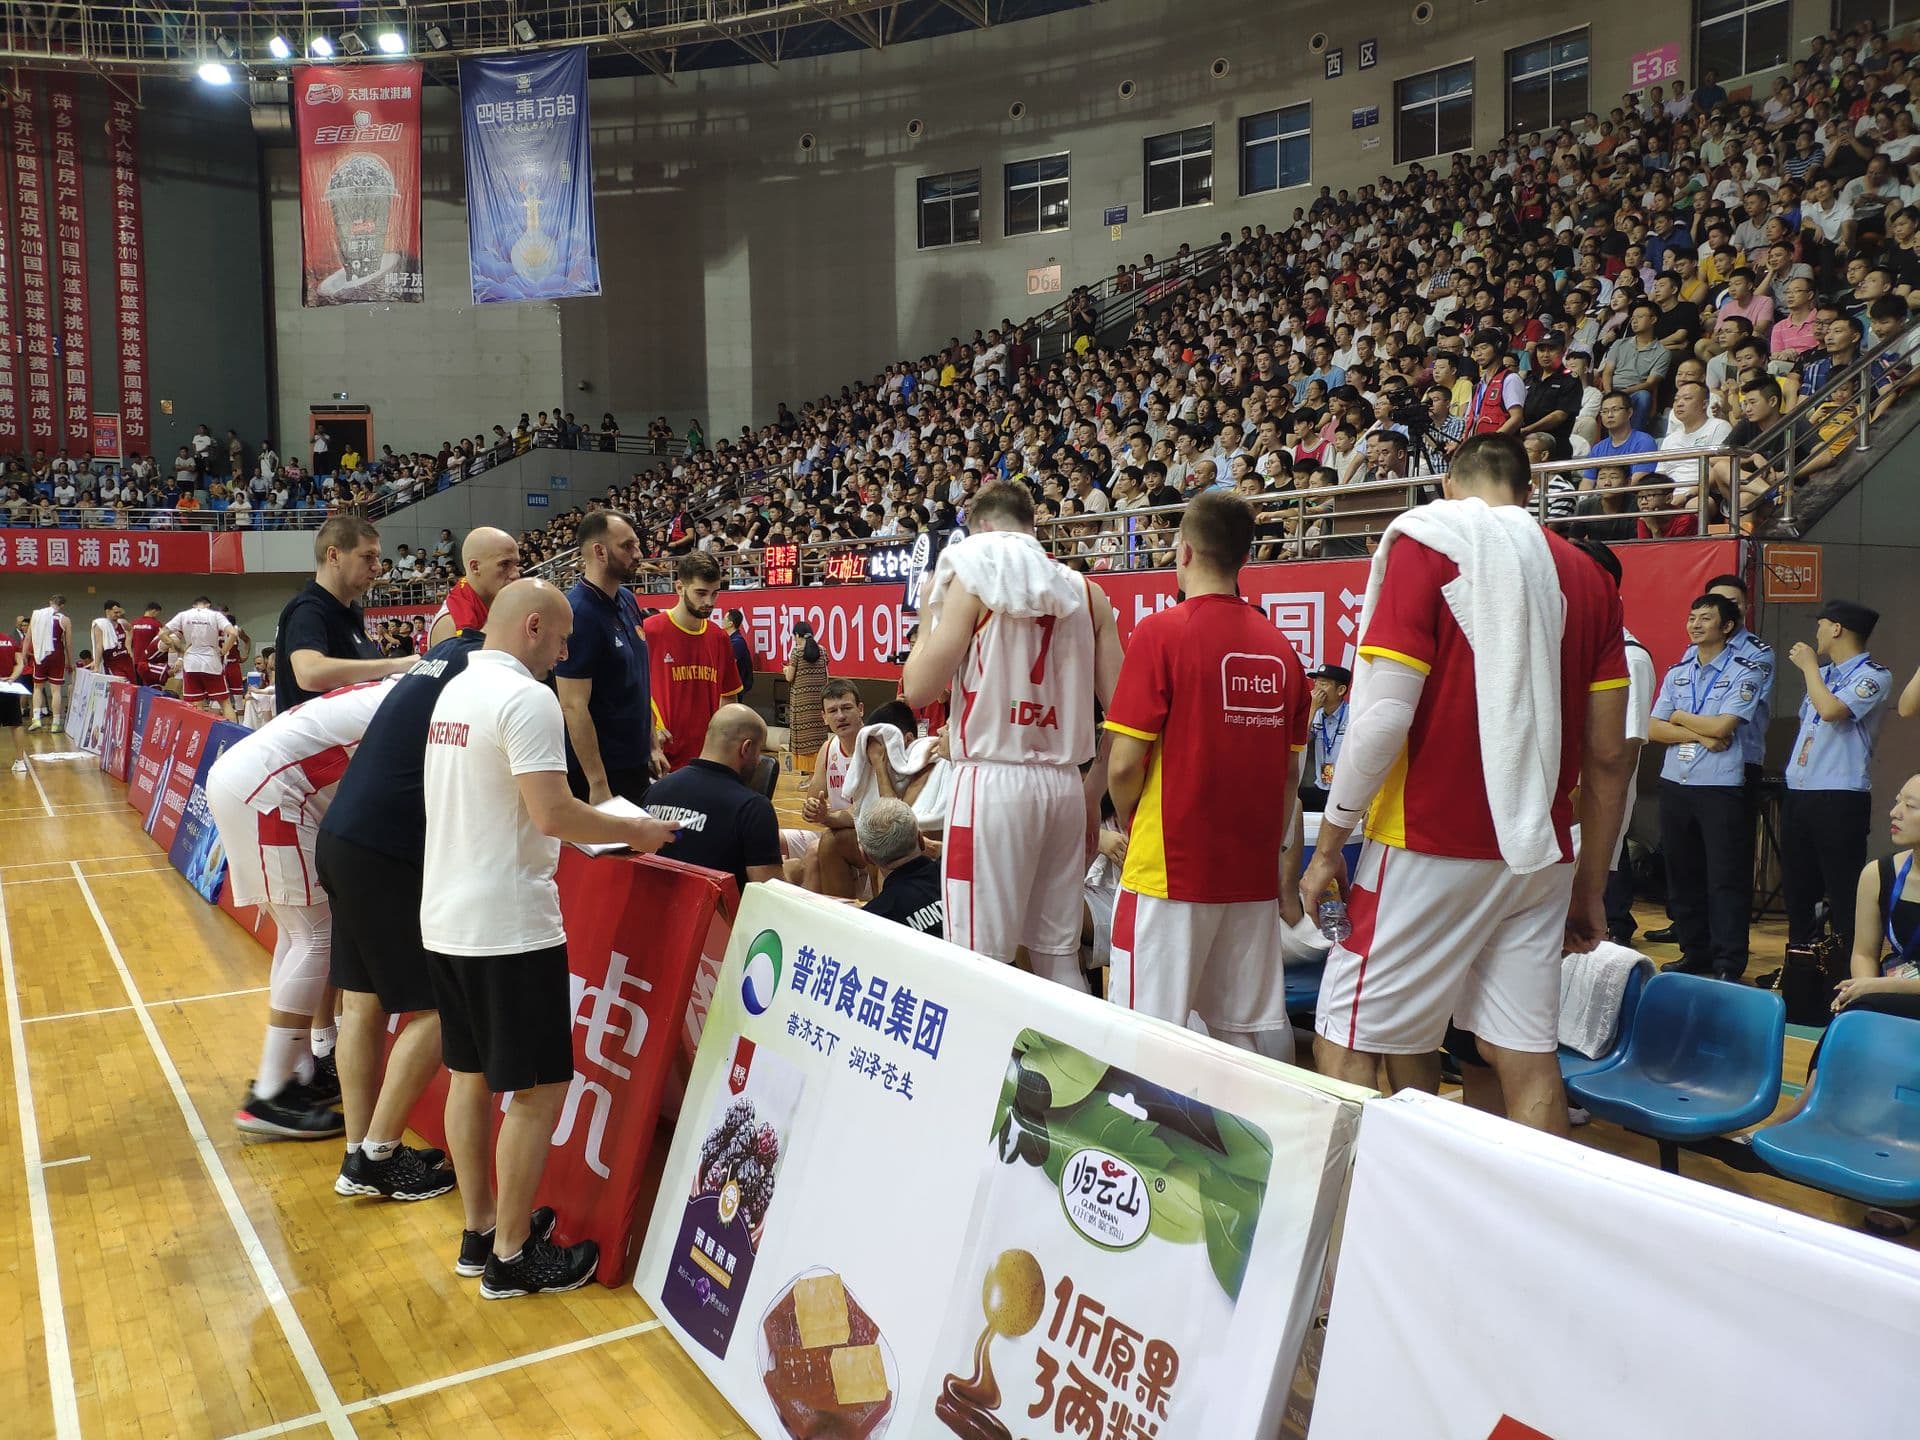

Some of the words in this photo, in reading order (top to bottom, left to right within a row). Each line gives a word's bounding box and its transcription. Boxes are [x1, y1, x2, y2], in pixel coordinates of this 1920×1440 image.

[1632, 56, 1678, 85] E3区
[1231, 672, 1279, 694] m:tel
[791, 945, 949, 1061] 普润食品集团
[786, 1011, 841, 1057] 普济天下
[848, 1046, 914, 1101] 润泽苍生
[1048, 1275, 1180, 1423] 1斤原果
